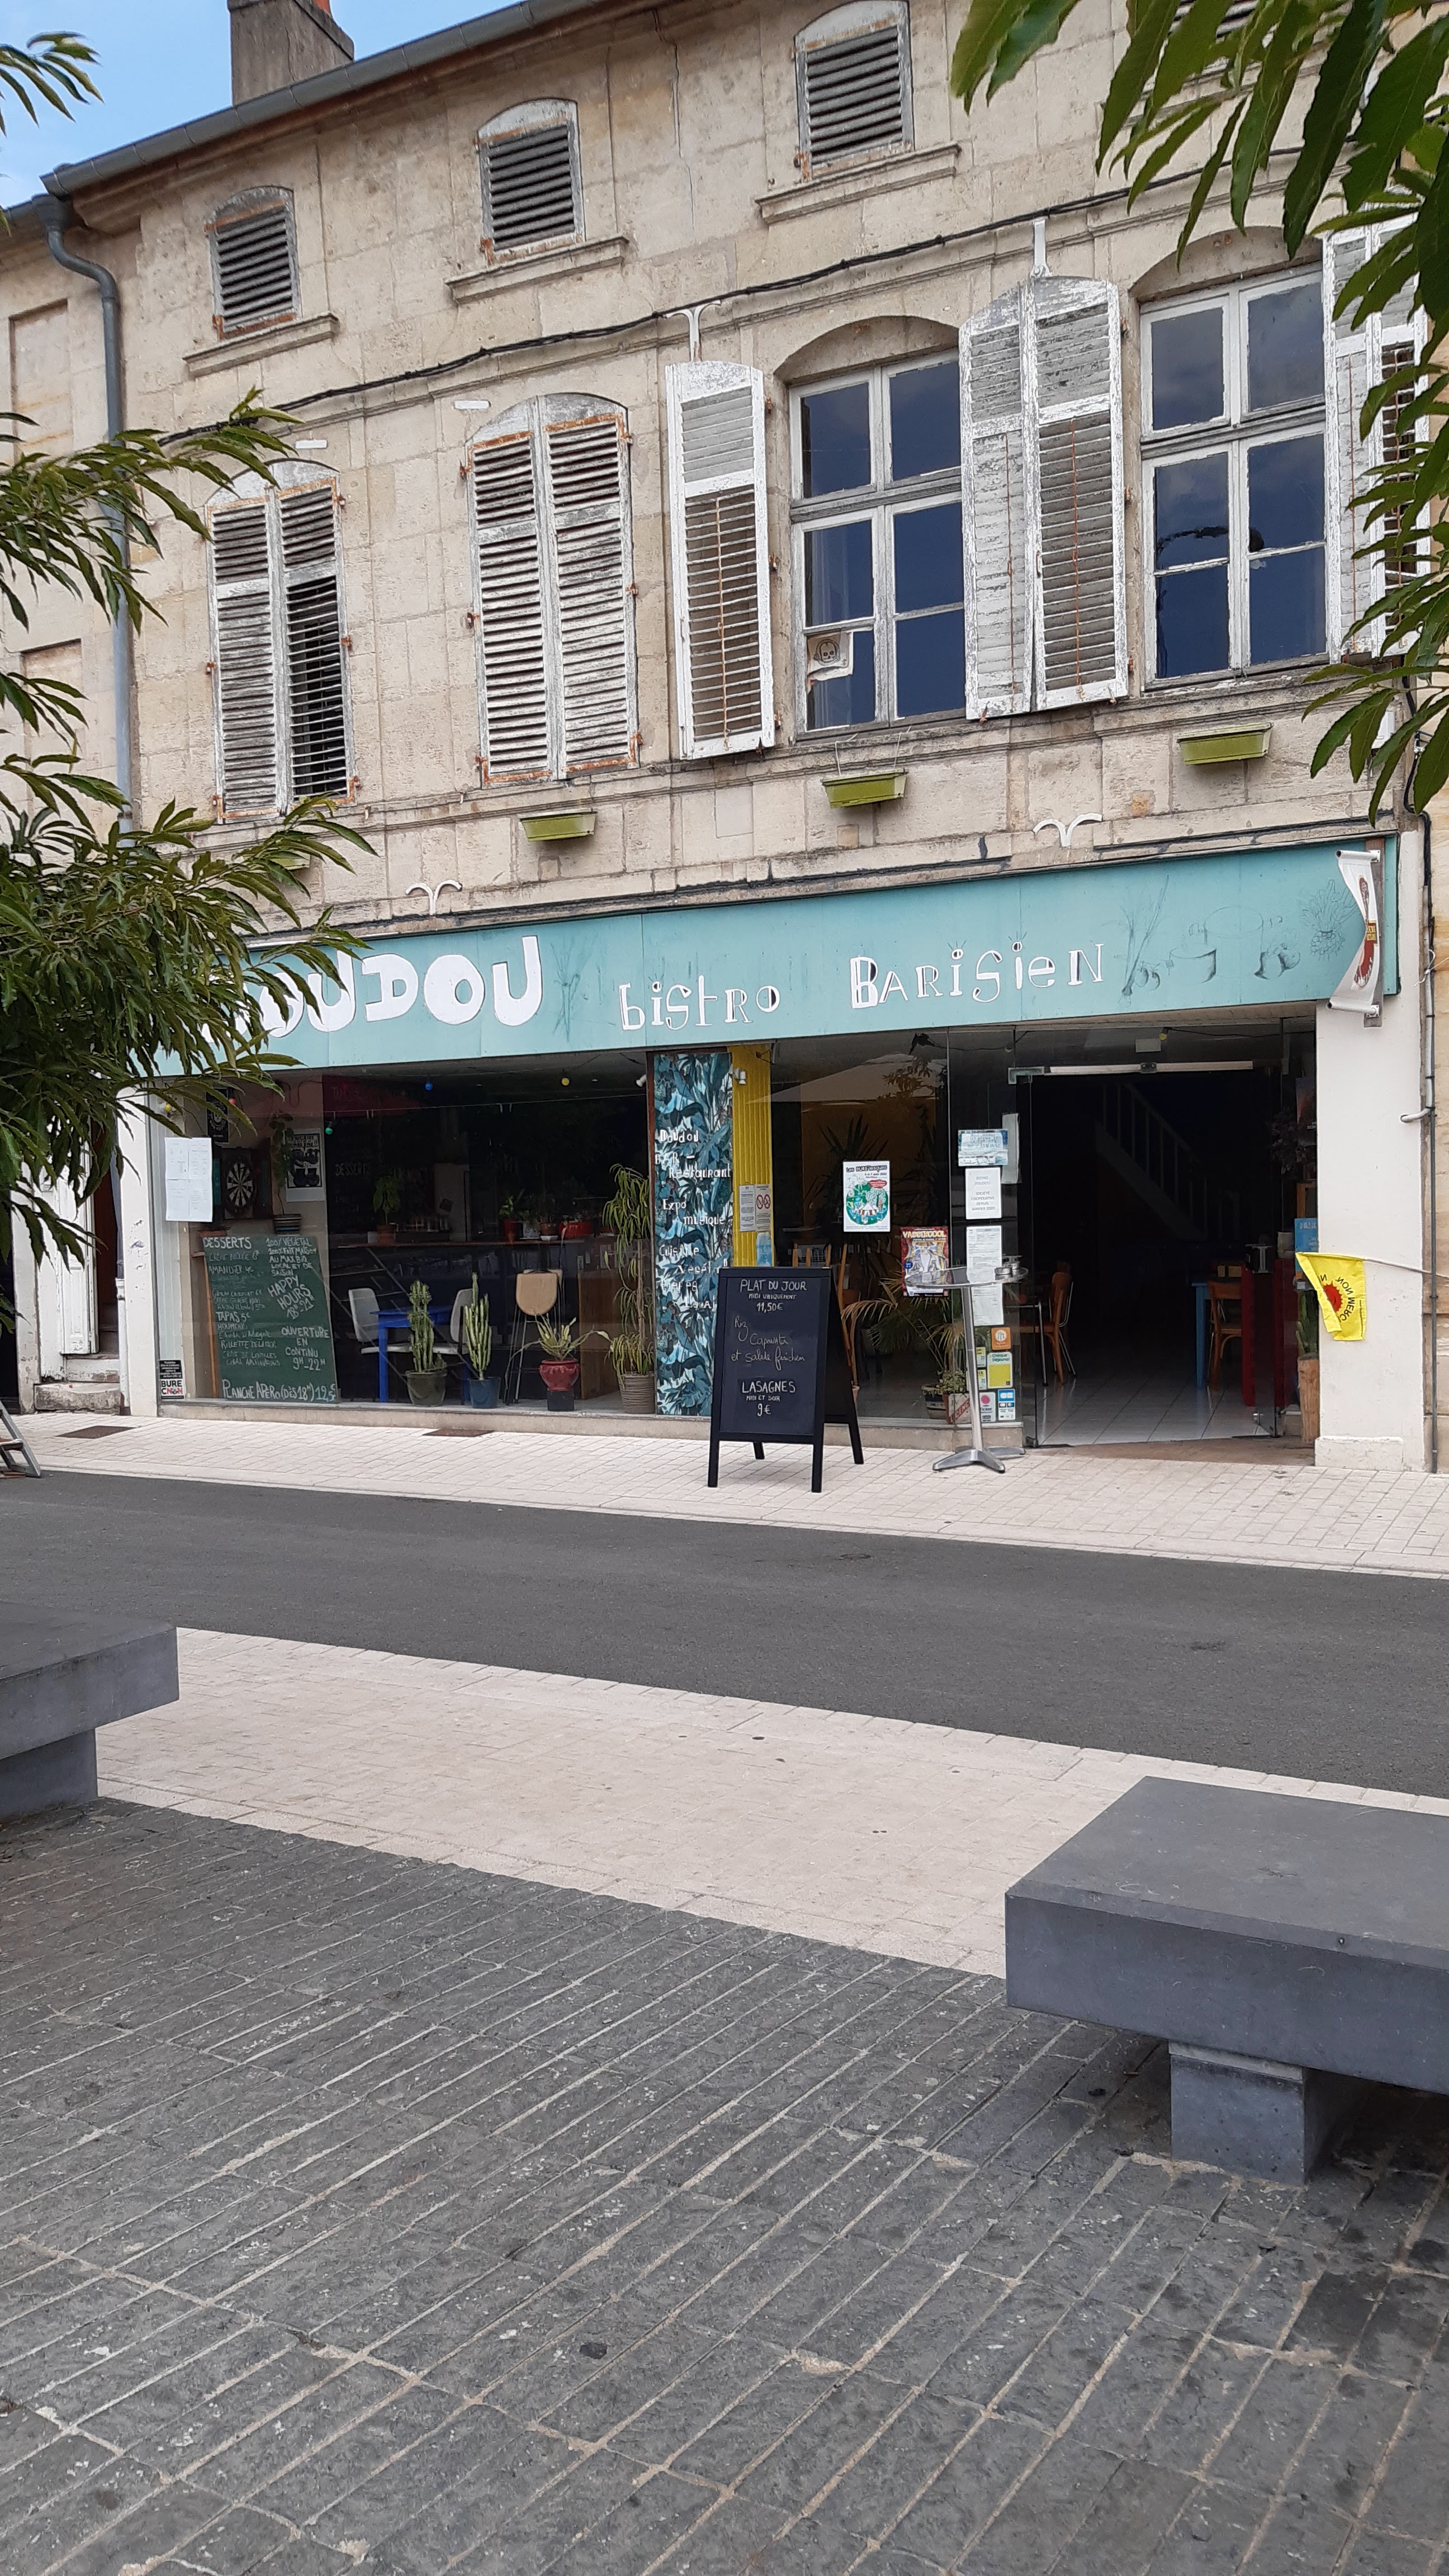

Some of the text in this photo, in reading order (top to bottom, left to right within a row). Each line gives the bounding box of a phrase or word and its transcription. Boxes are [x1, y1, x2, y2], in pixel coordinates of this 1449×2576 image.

[200, 935, 542, 1044] OUDOU
[203, 1237, 252, 1249] DESSERTS
[268, 1275, 299, 1297] HAPPY
[740, 1279, 807, 1292] PLAT DU JOUR
[277, 1284, 312, 1310] HOURS
[756, 1302, 783, 1313] 11,50€
[215, 1311, 240, 1323] TAPAS
[281, 1325, 330, 1338] OUVERTURE
[735, 1315, 749, 1342] Riz
[731, 1349, 742, 1361] et
[222, 1379, 255, 1399] PLANCHE
[742, 1380, 796, 1393] LASAGNES
